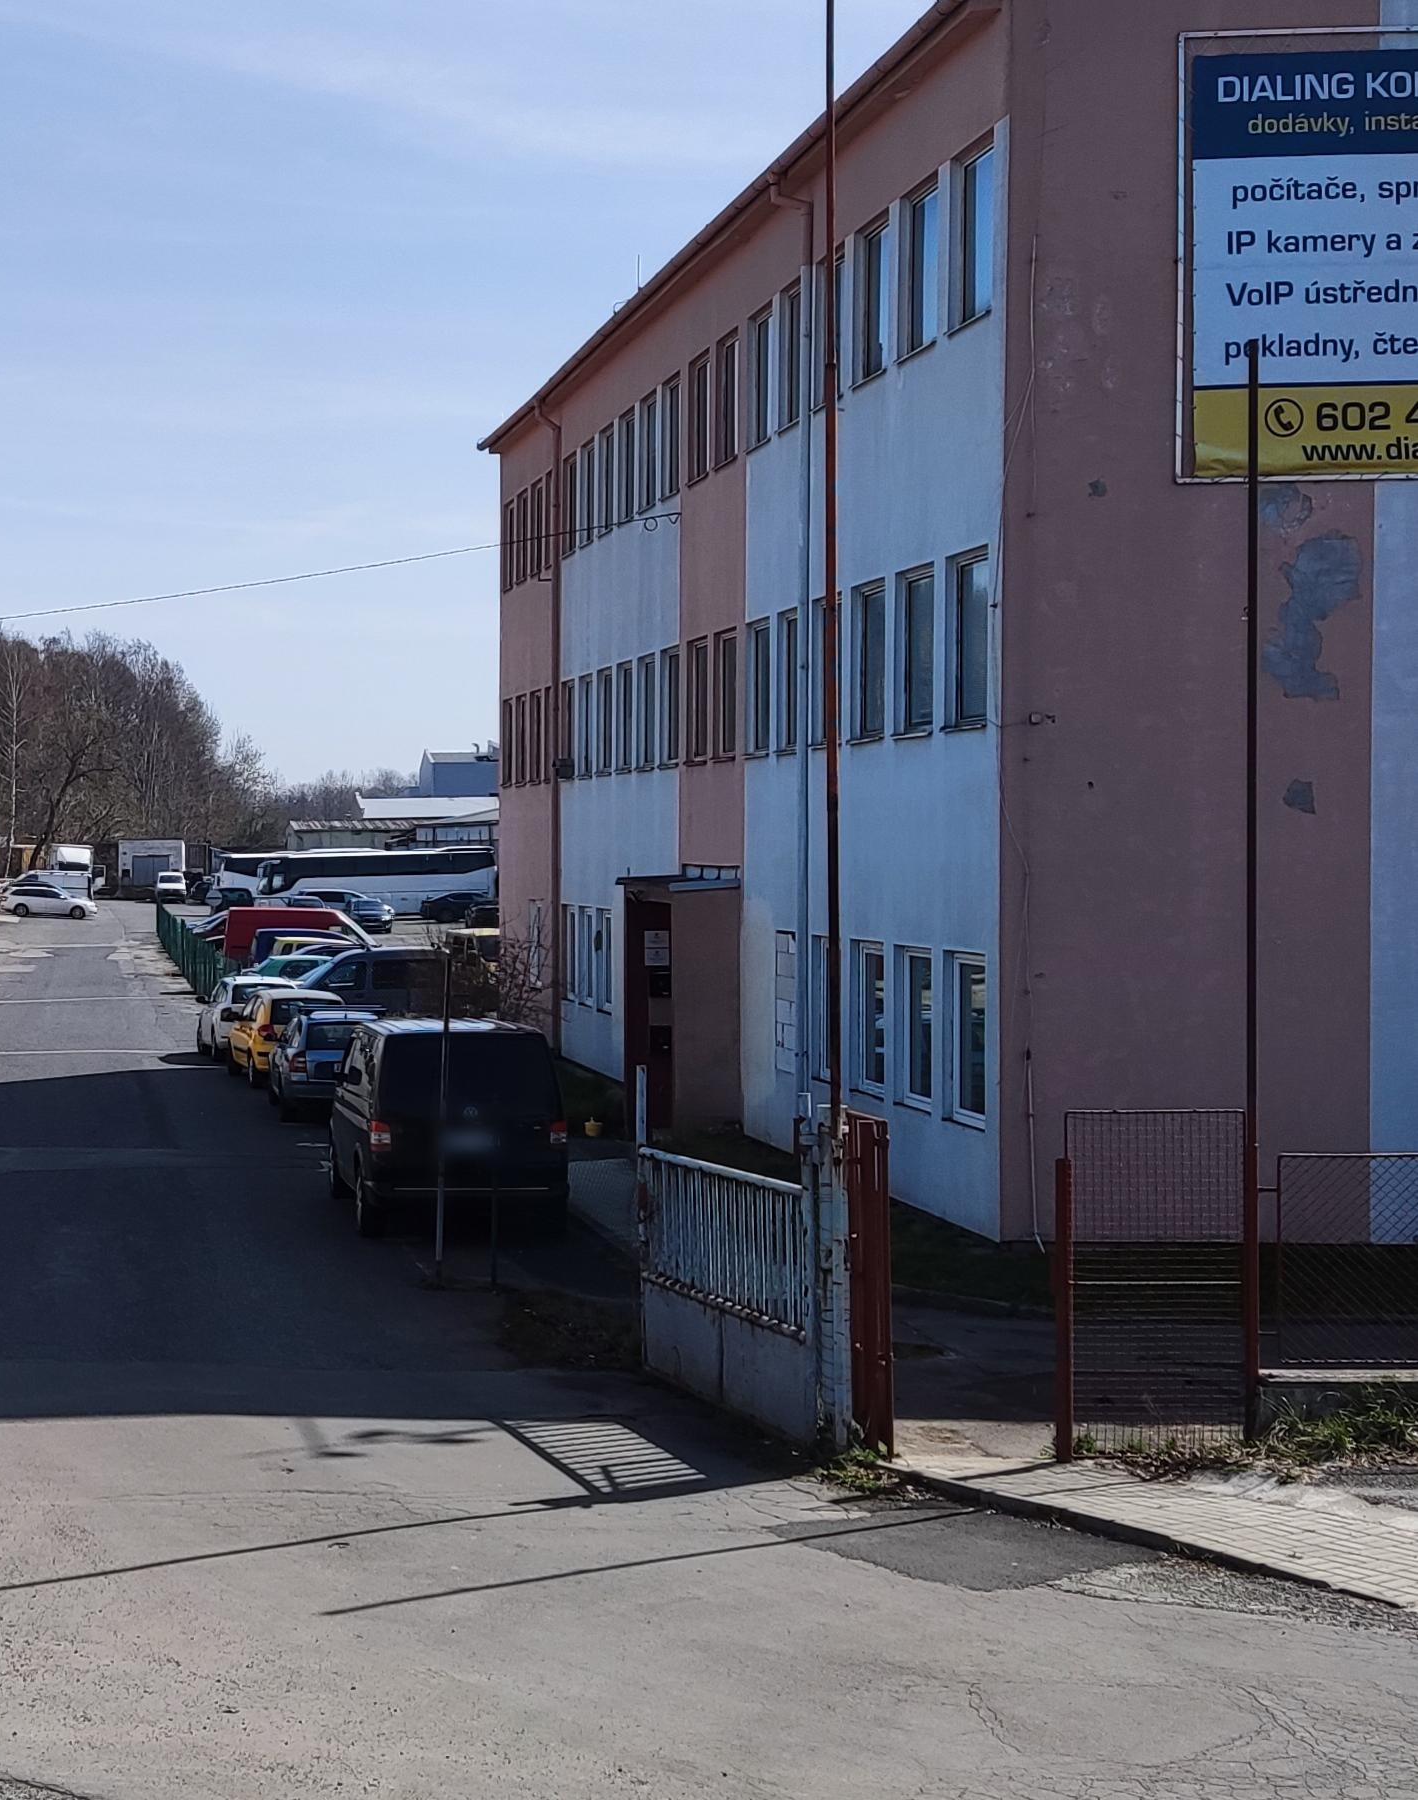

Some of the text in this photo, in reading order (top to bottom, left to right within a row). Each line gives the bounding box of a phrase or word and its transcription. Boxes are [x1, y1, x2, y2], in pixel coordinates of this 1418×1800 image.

[1217, 71, 1418, 103] DIALING KO
[1248, 111, 1355, 137] dodávky,
[1232, 176, 1366, 210] počítače,
[1227, 231, 1256, 255] IP
[1267, 230, 1376, 258] kamery
[1386, 233, 1402, 251] a
[1225, 279, 1418, 306] VoIP ústředn
[1373, 332, 1418, 355] čte
[1316, 402, 1391, 432] 602
